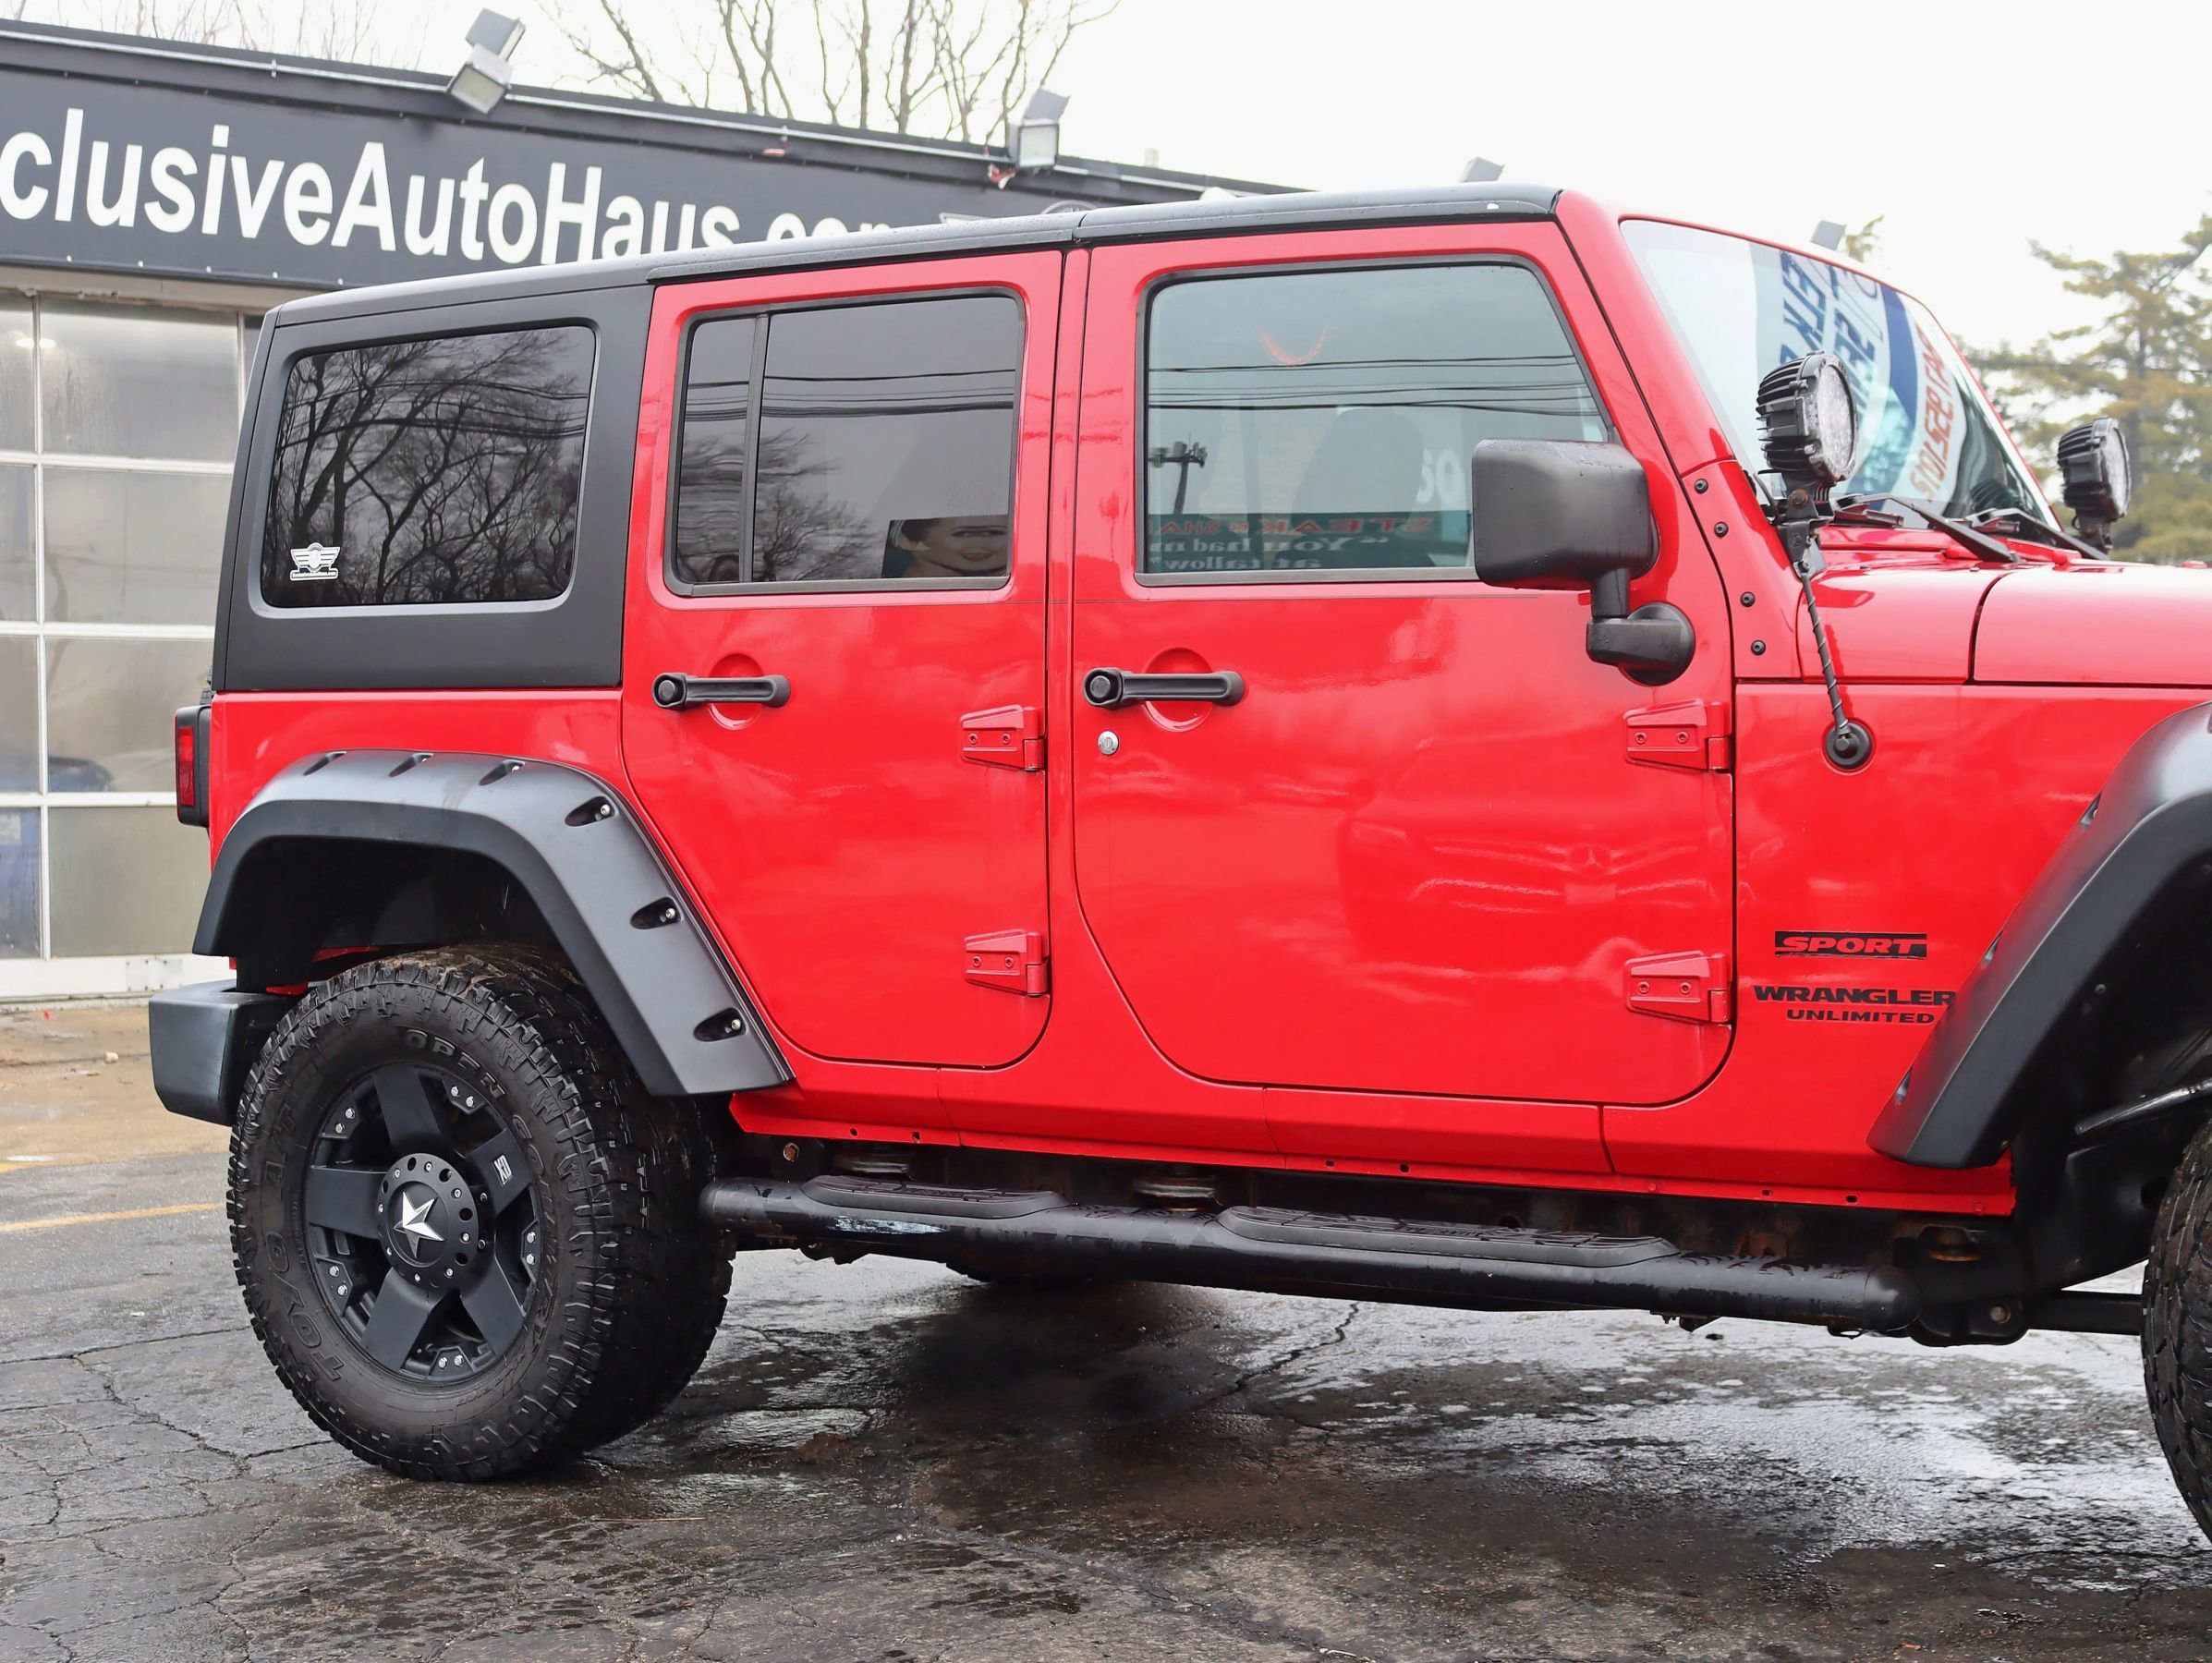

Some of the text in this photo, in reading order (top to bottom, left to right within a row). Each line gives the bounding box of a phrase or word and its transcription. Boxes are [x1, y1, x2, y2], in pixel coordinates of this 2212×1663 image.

[0, 108, 892, 264] clusiveAutoHaus
[1775, 934, 1926, 955] SPORT
[1754, 985, 1957, 1006] WRANGLER
[1787, 1008, 1935, 1025] UNLIMITED
[267, 1232, 344, 1383] TOYO
